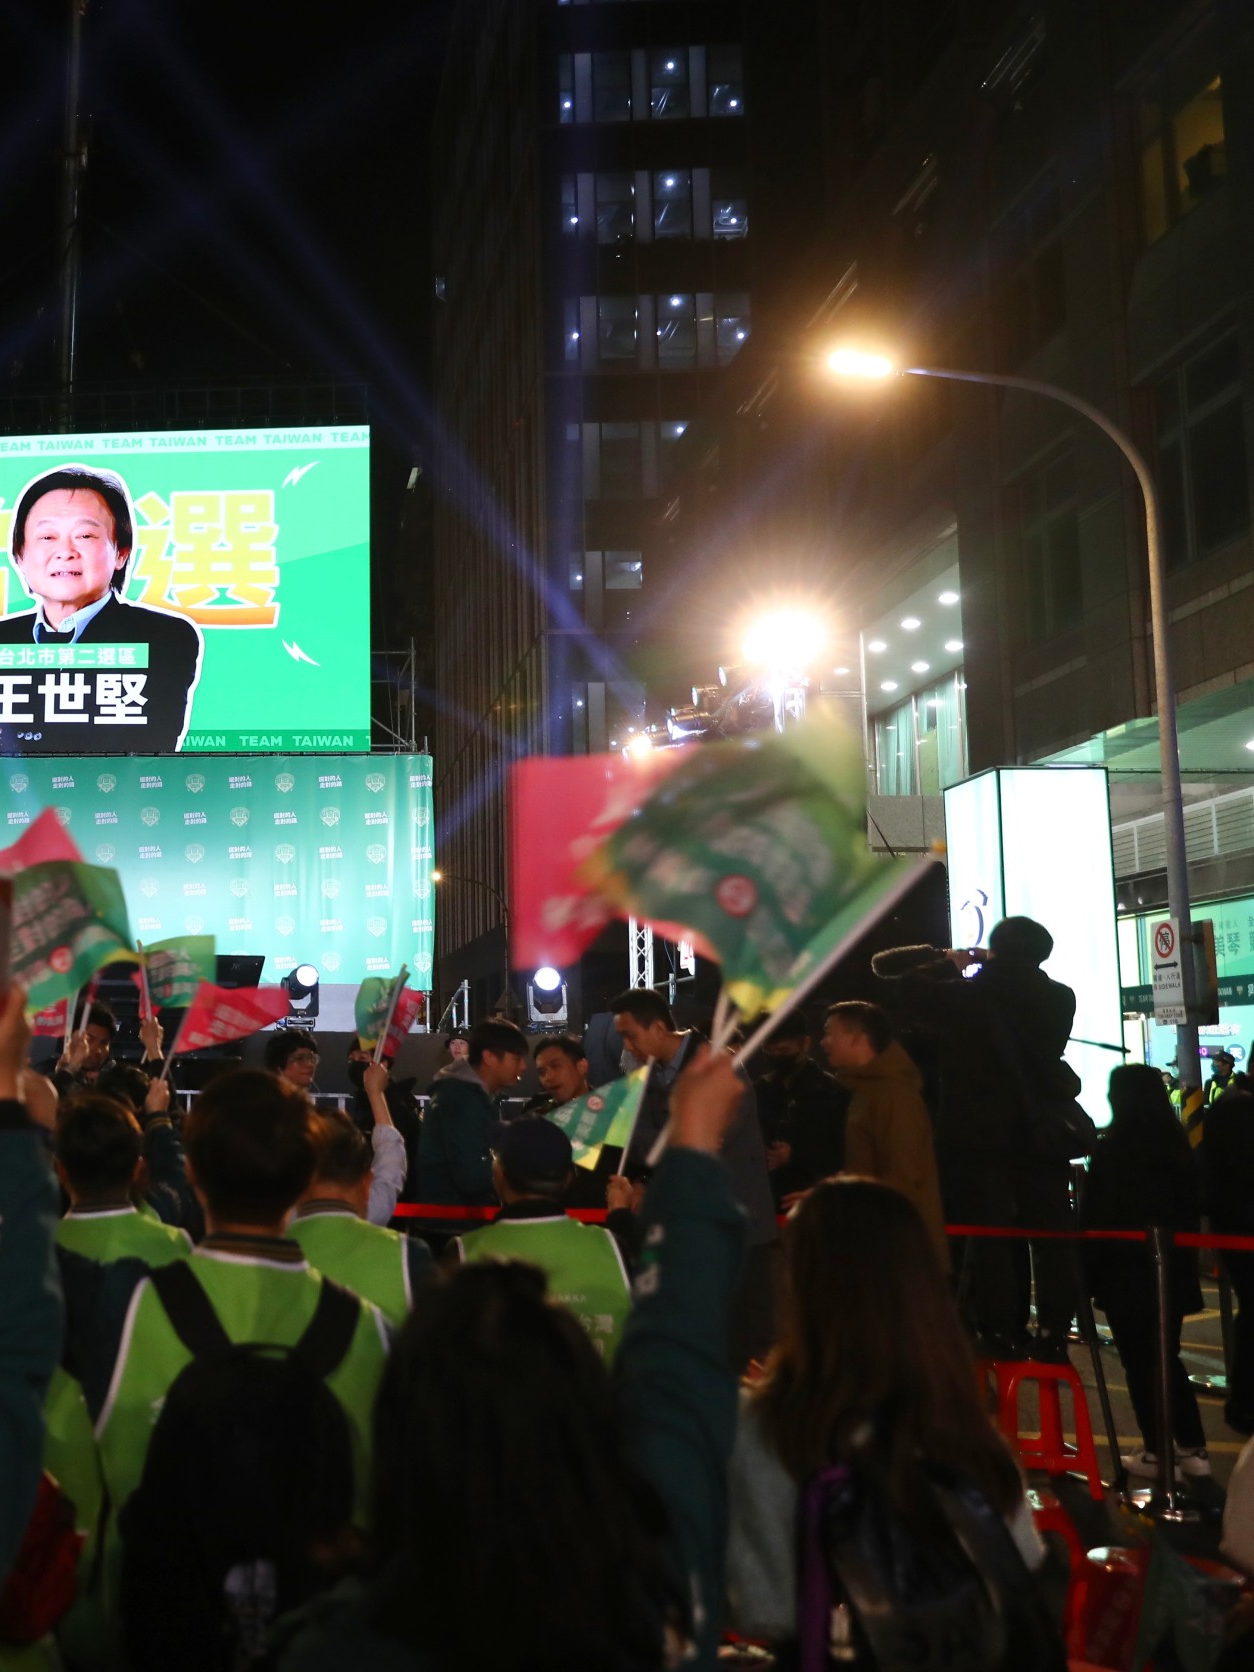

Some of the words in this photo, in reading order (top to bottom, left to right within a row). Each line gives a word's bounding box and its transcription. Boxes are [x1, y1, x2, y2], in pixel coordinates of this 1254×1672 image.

[37, 439, 94, 451] TAIWAN
[102, 438, 143, 449] TEAM
[148, 436, 207, 448] TAIWAN
[215, 435, 257, 446] TEAM
[263, 433, 322, 445] TAIWAN
[239, 735, 283, 747] TEAM
[292, 735, 354, 747] TAIWAN
